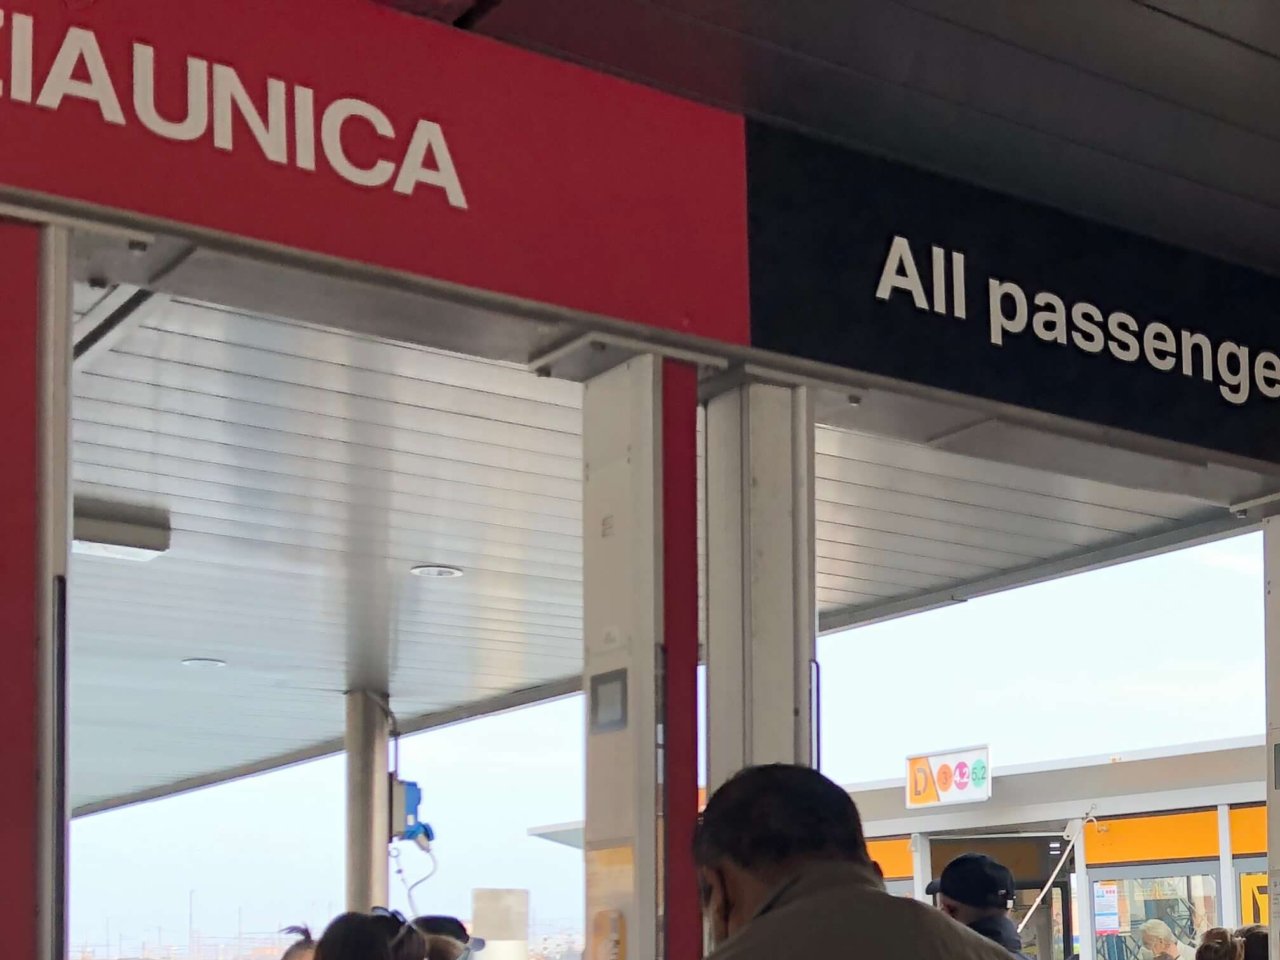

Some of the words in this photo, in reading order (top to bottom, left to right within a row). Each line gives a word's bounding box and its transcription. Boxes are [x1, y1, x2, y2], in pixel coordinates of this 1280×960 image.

[0, 9, 468, 209] IAUNICA
[875, 235, 966, 319] All
[954, 766, 969, 784] 4.2
